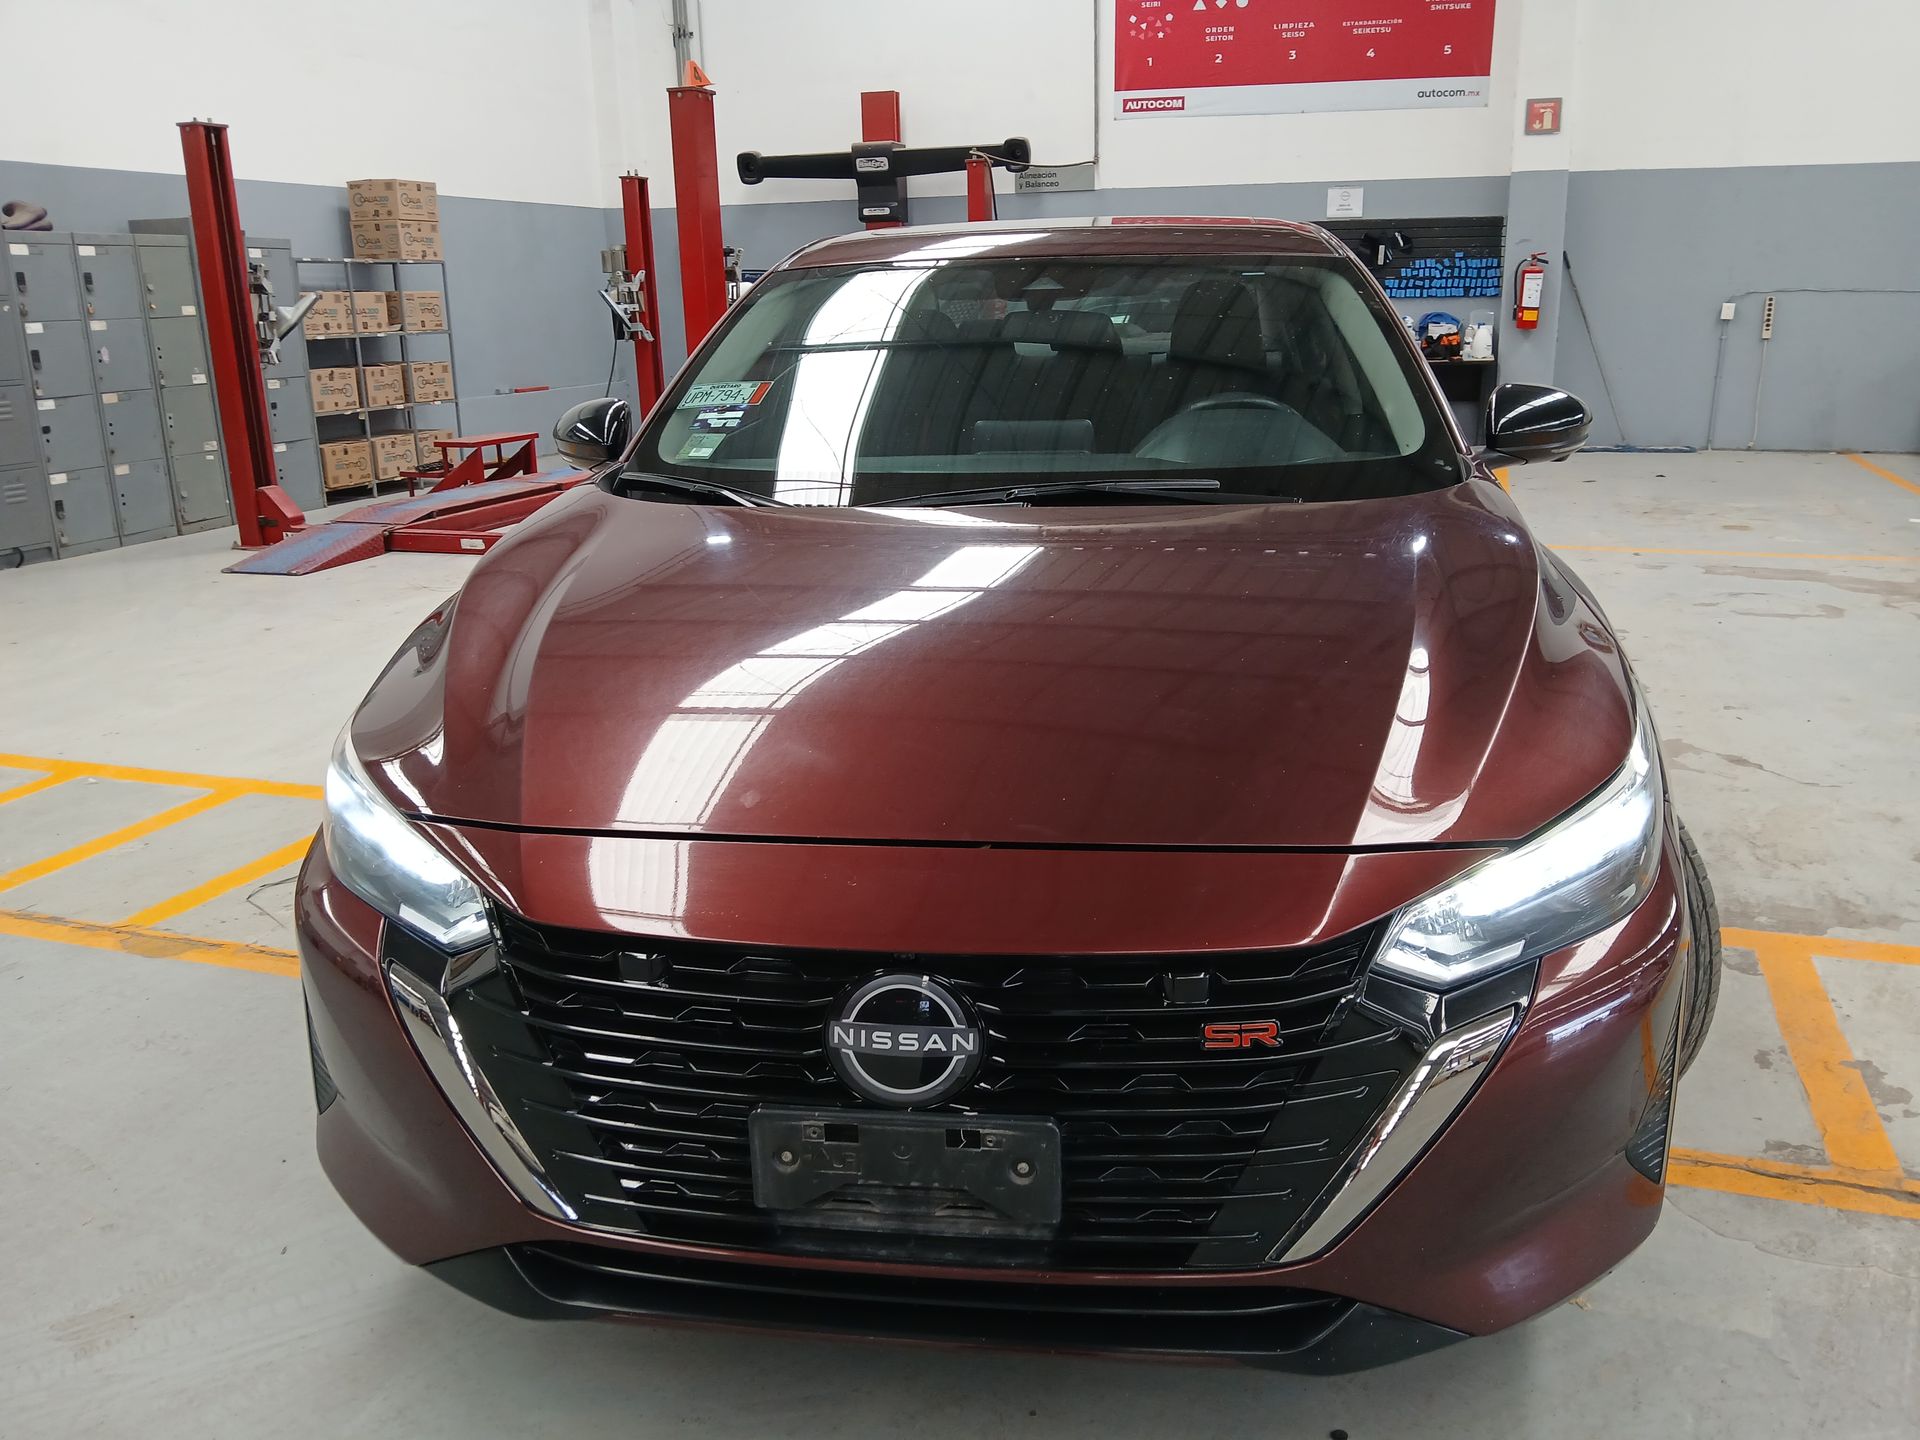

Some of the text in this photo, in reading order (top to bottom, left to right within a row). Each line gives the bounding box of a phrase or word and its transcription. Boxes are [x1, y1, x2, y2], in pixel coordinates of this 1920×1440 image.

[1141, 0, 1161, 8] SEIRI
[1430, 2, 1472, 11] SHITSUKE
[1205, 26, 1235, 34] ORDEN
[1273, 21, 1315, 30] LIMPIEZA
[1352, 27, 1392, 35] SEIKETSU
[1366, 48, 1376, 58] 4
[1443, 44, 1452, 55] 5
[1214, 53, 1223, 64] 2
[1288, 50, 1297, 60] 3
[1146, 57, 1153, 67] 1
[1417, 88, 1480, 98] autocom.mx
[1125, 99, 1182, 110] AUTOCOM
[1025, 180, 1060, 188] Balanceo
[684, 388, 756, 405] UPM-794-J
[833, 1025, 974, 1052] NISSAN
[1203, 1021, 1283, 1050] SR
